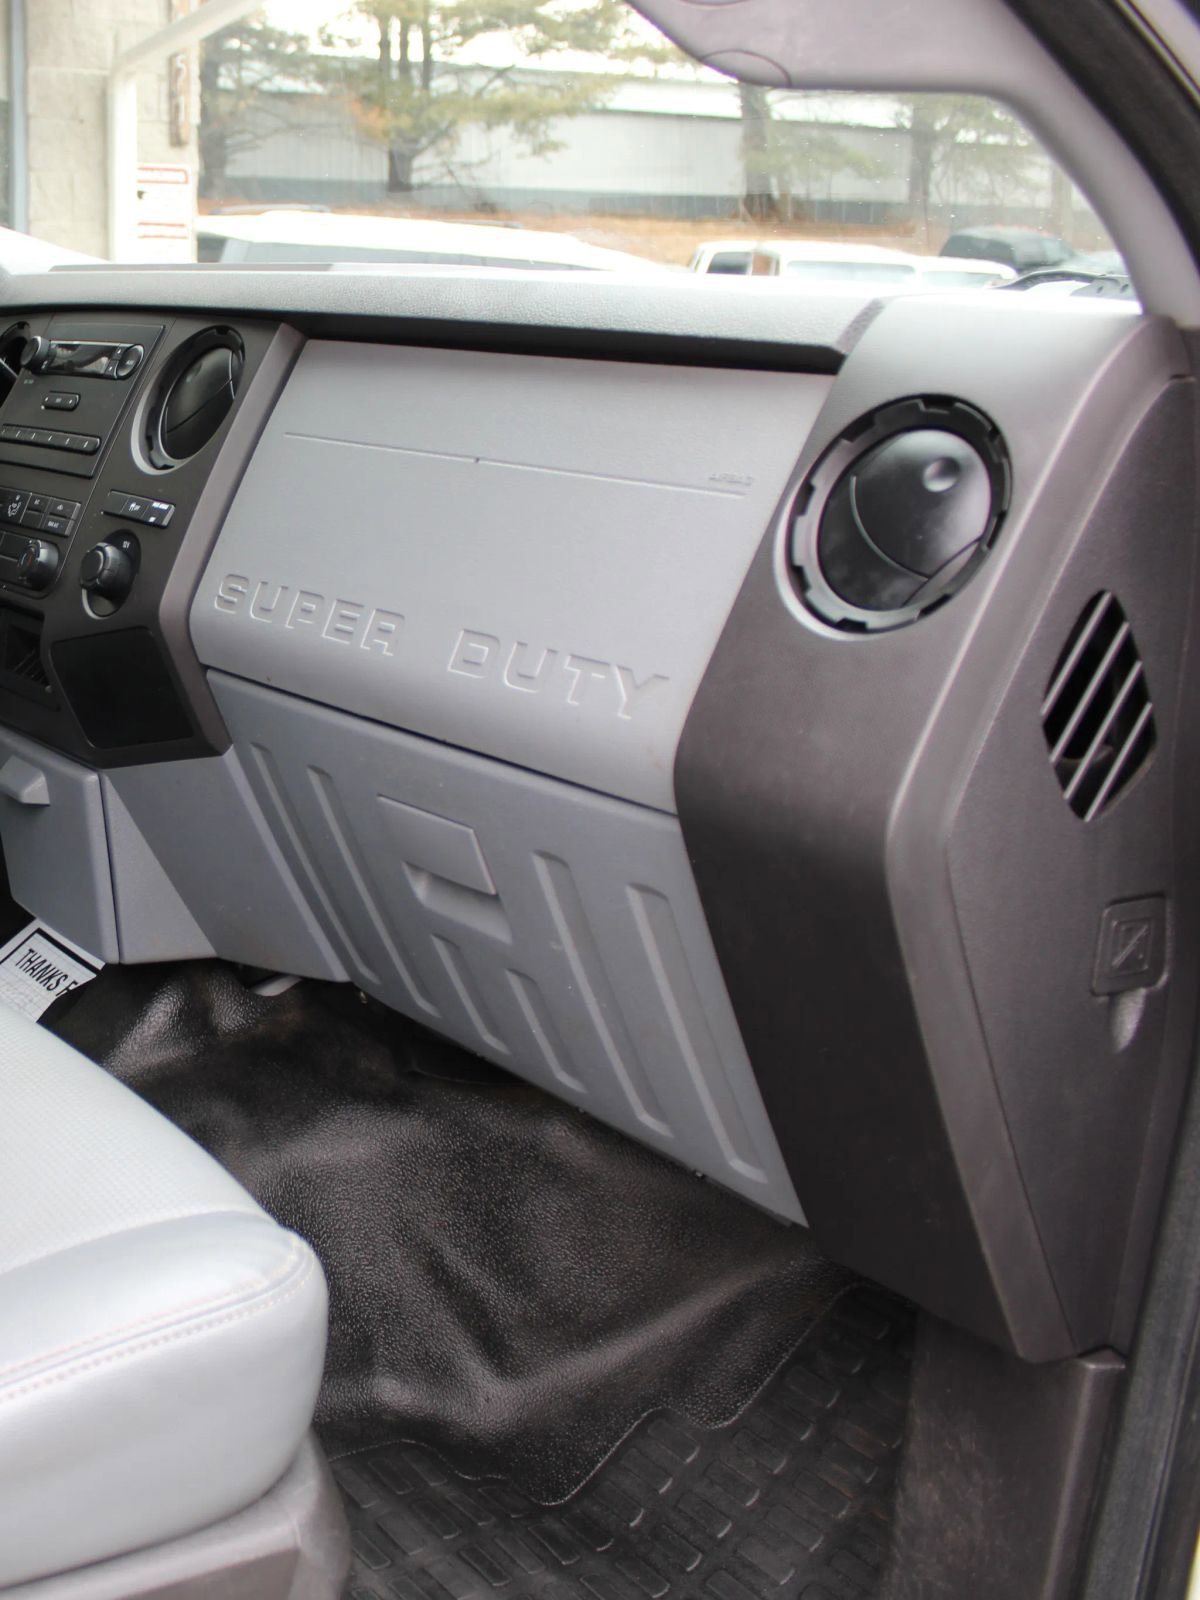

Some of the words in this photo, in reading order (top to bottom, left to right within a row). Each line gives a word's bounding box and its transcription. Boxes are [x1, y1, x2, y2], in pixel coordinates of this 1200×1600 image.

[213, 573, 406, 657] SUPER
[446, 627, 670, 720] DUTY
[14, 947, 69, 992] THANKS
